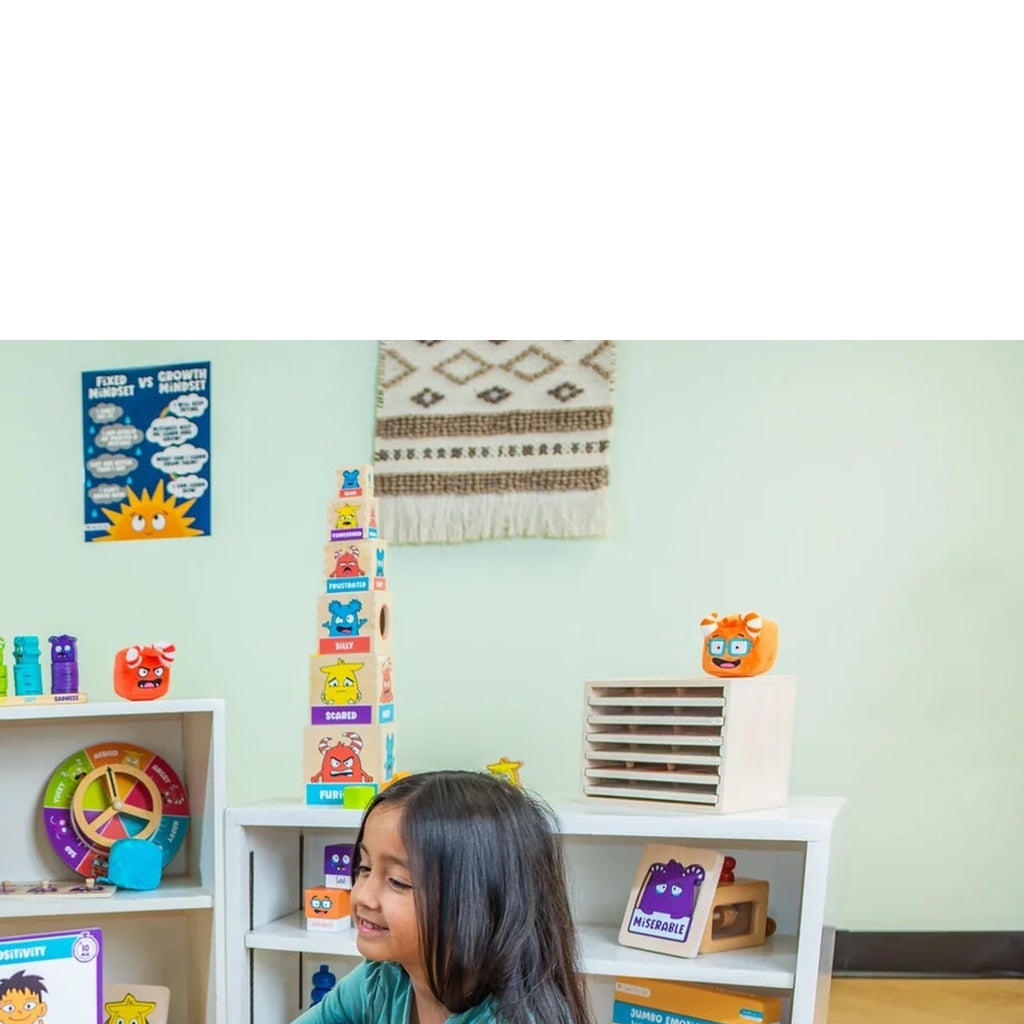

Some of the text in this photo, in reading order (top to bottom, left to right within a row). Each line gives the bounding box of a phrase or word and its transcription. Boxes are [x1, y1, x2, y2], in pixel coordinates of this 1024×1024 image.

[157, 368, 208, 382] GROWTH
[138, 376, 154, 388] VS
[329, 581, 366, 590] FRUSTRATED
[325, 711, 357, 720] SCARED
[94, 750, 119, 760] AFRAID
[152, 764, 171, 783] ANGRY
[64, 845, 78, 858] SAD
[630, 1008, 663, 1023] JUMBO
